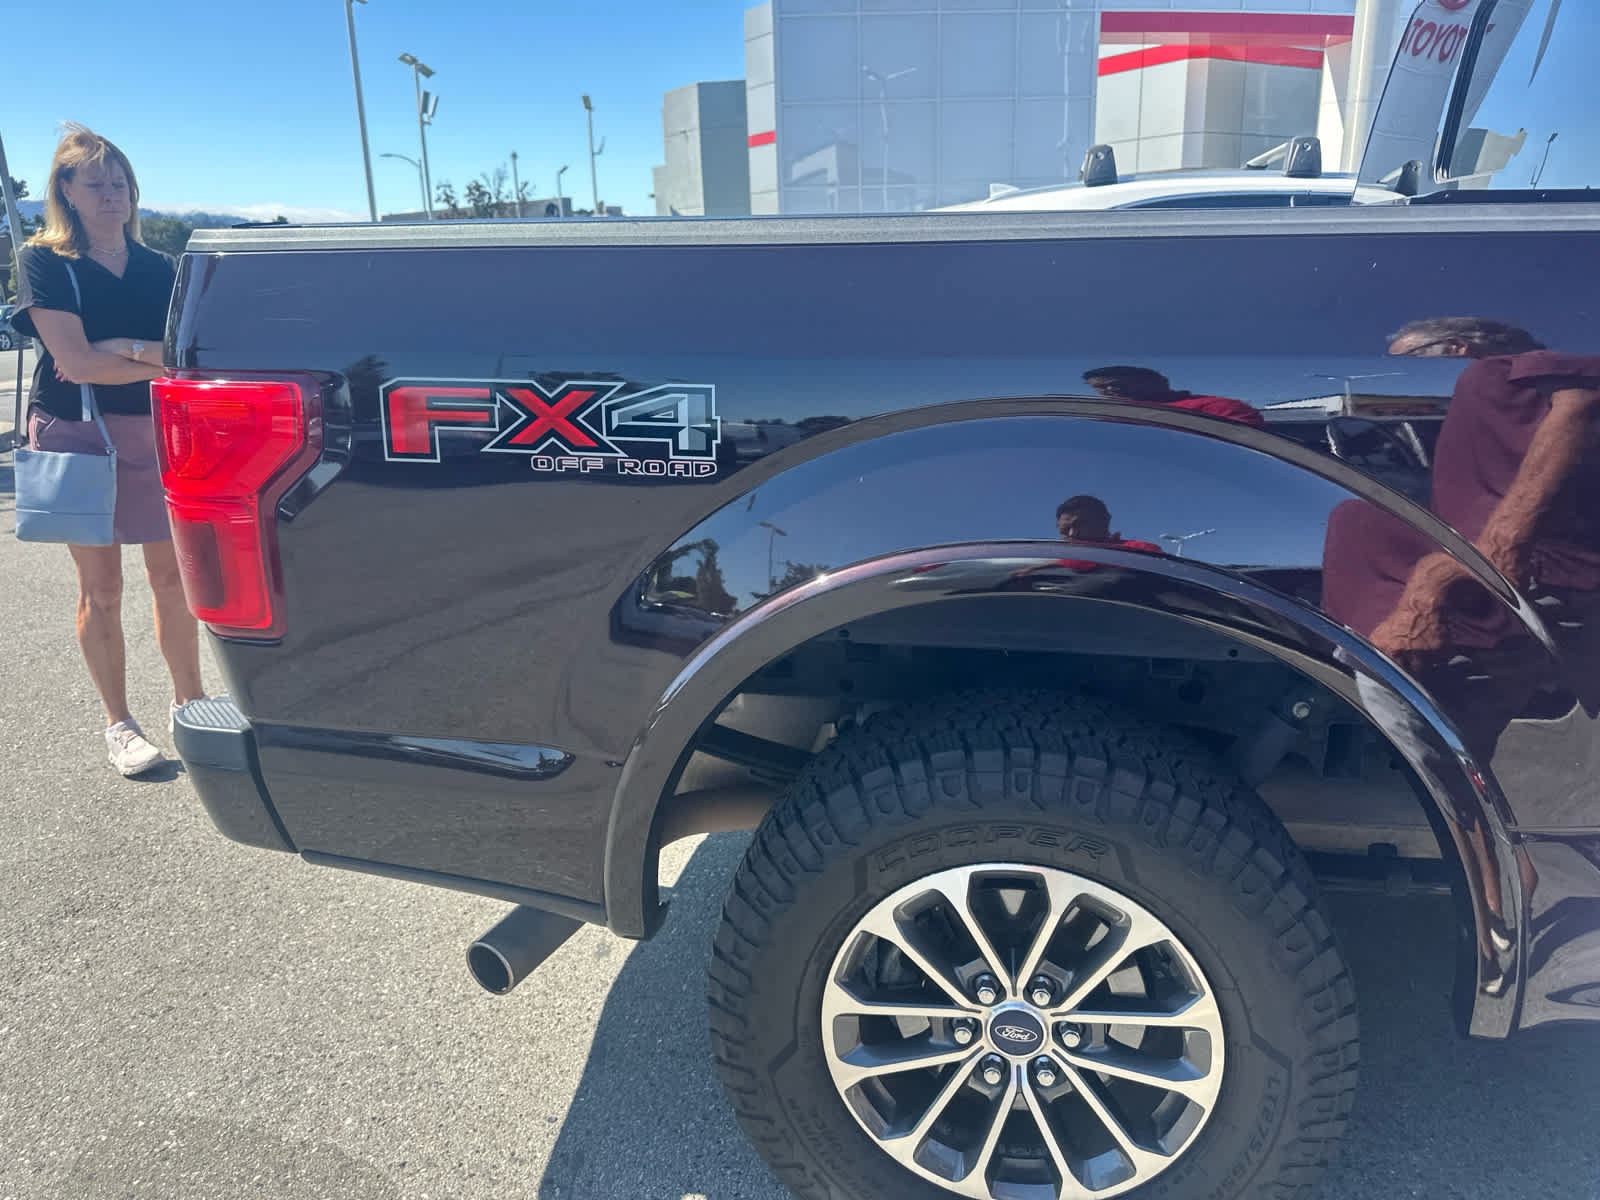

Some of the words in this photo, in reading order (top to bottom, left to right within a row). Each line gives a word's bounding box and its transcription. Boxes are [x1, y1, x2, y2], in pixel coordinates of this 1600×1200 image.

[379, 377, 721, 463] FX4
[531, 455, 604, 473] OFF
[617, 458, 717, 477] ROAD
[876, 824, 1107, 873] COOPER
[1000, 1026, 1031, 1040] Ford
